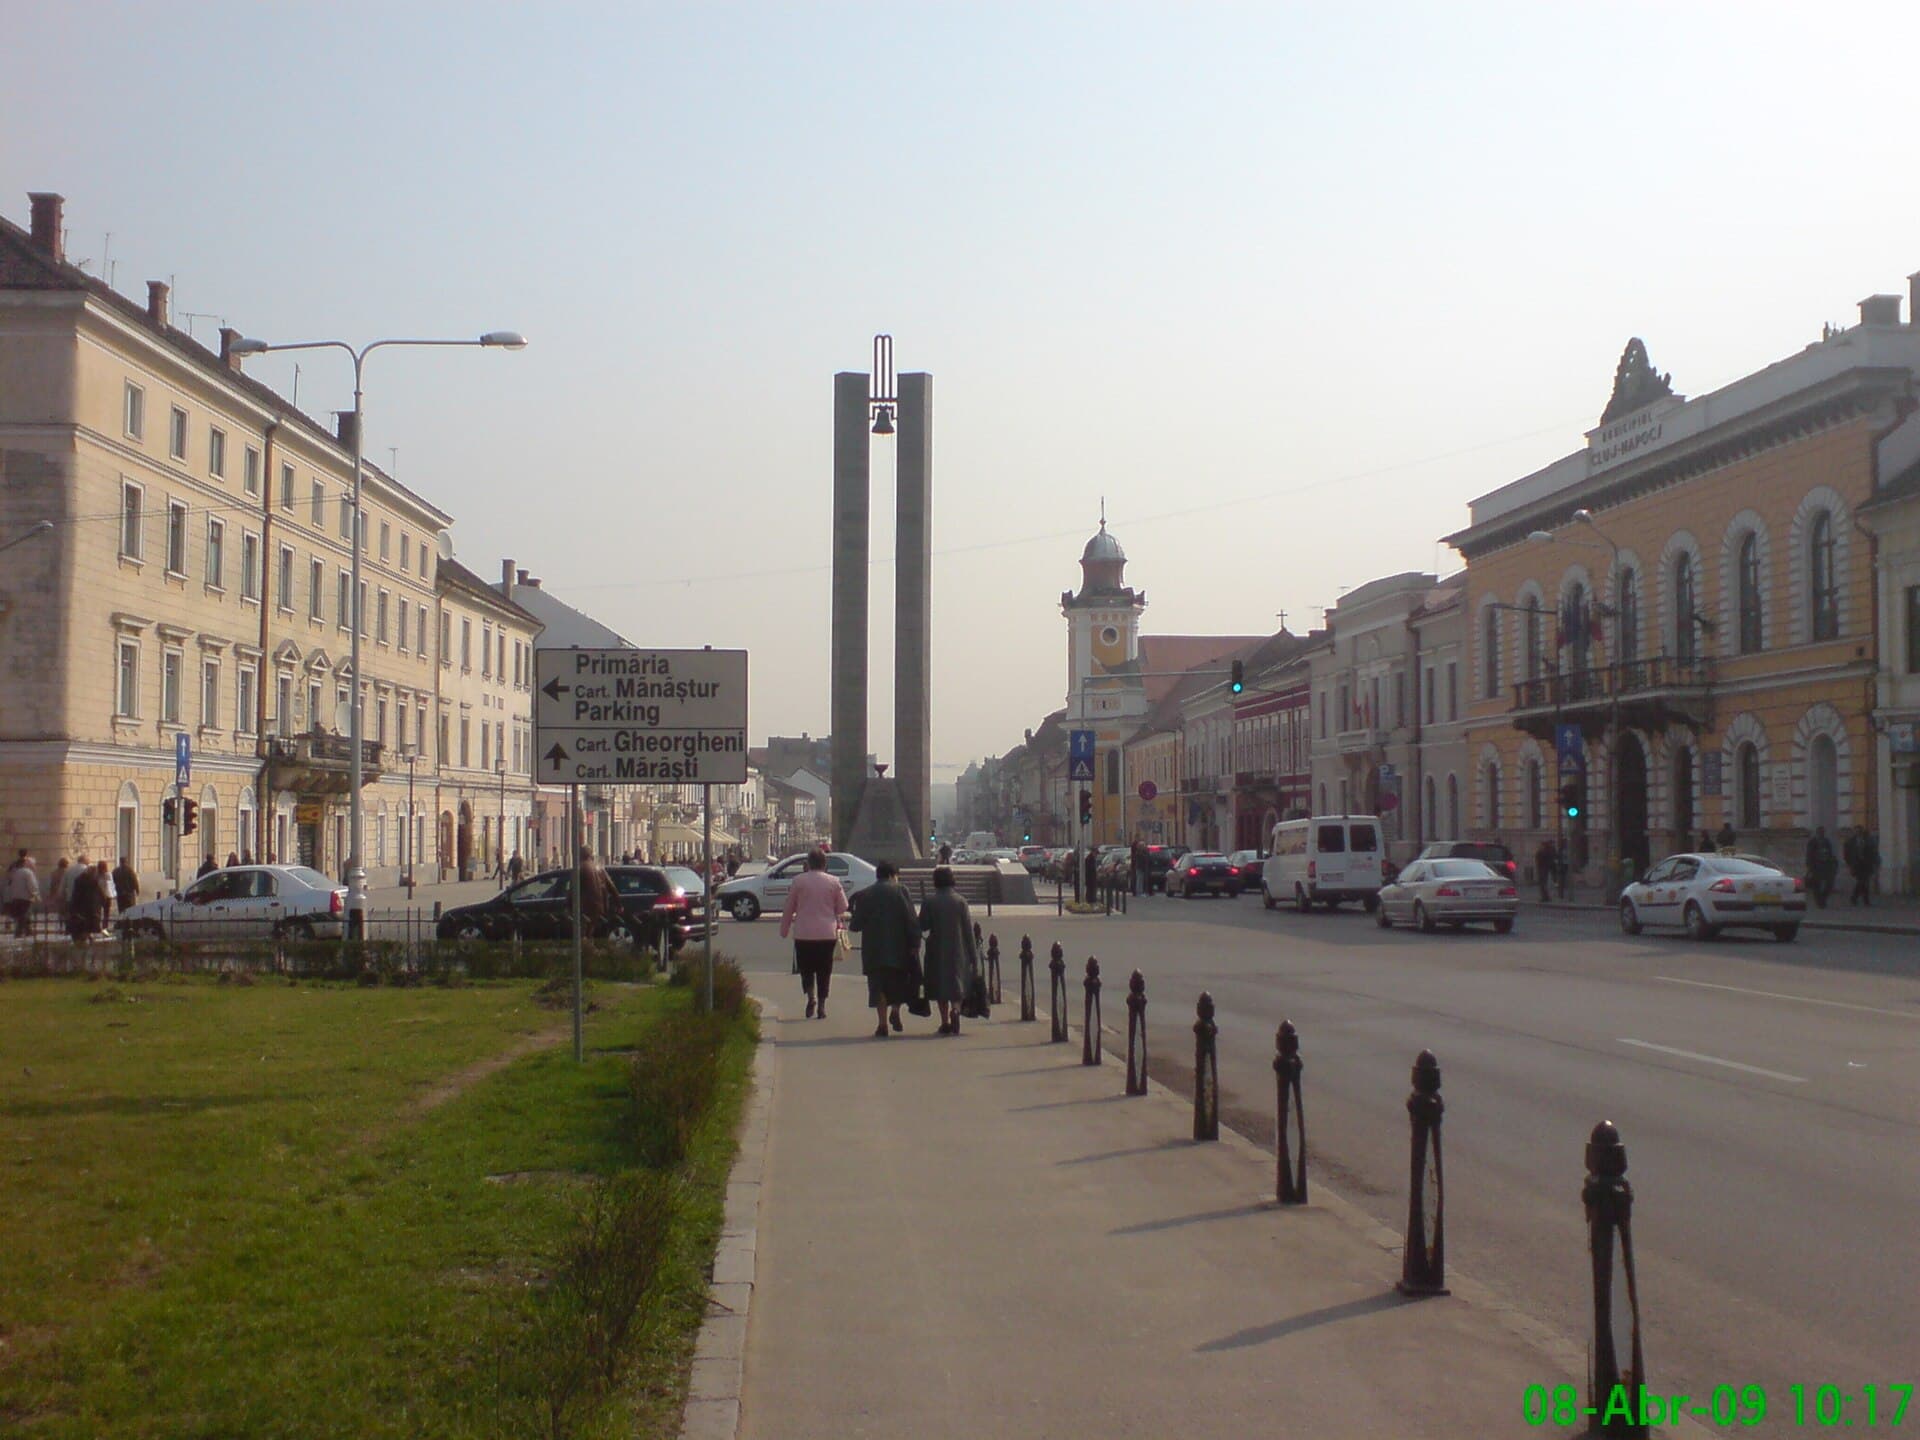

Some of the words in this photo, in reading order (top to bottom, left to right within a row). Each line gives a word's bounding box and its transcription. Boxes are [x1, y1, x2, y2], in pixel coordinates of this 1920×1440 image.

[574, 685, 611, 699] Cart.
[574, 701, 660, 725] Parking
[575, 738, 611, 752] Cart.
[613, 731, 744, 757] Gheorgheni
[575, 764, 612, 778] Cart.
